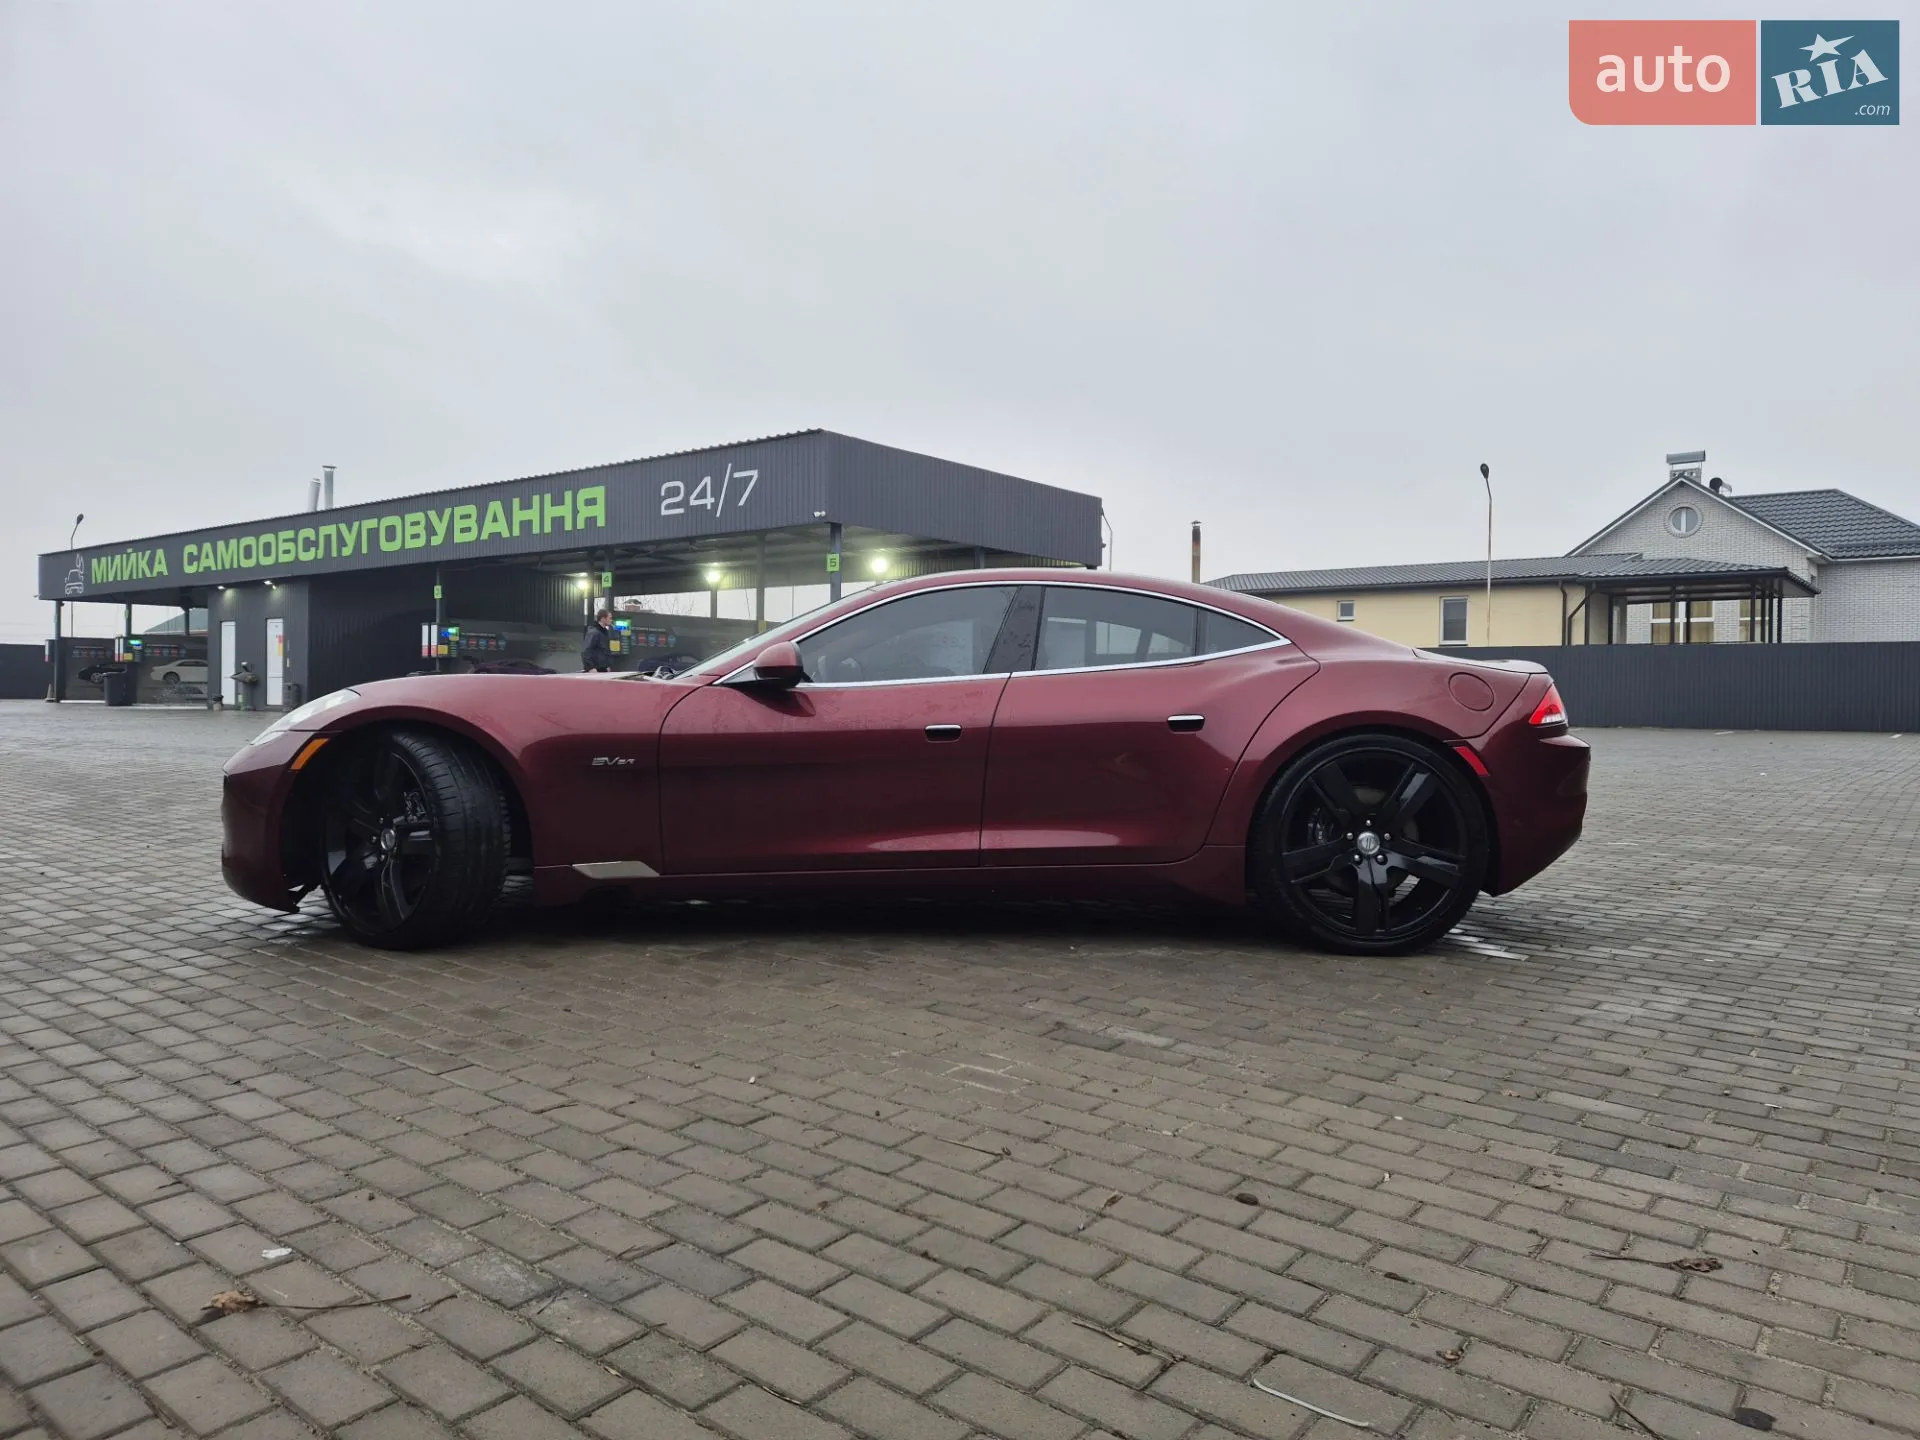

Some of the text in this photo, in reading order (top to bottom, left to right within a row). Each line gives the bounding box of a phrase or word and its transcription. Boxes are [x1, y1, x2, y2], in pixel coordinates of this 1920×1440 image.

[659, 463, 759, 518] 24/7
[91, 484, 607, 583] МИЙКА САМООБСЛУГОВУВАННЯ
